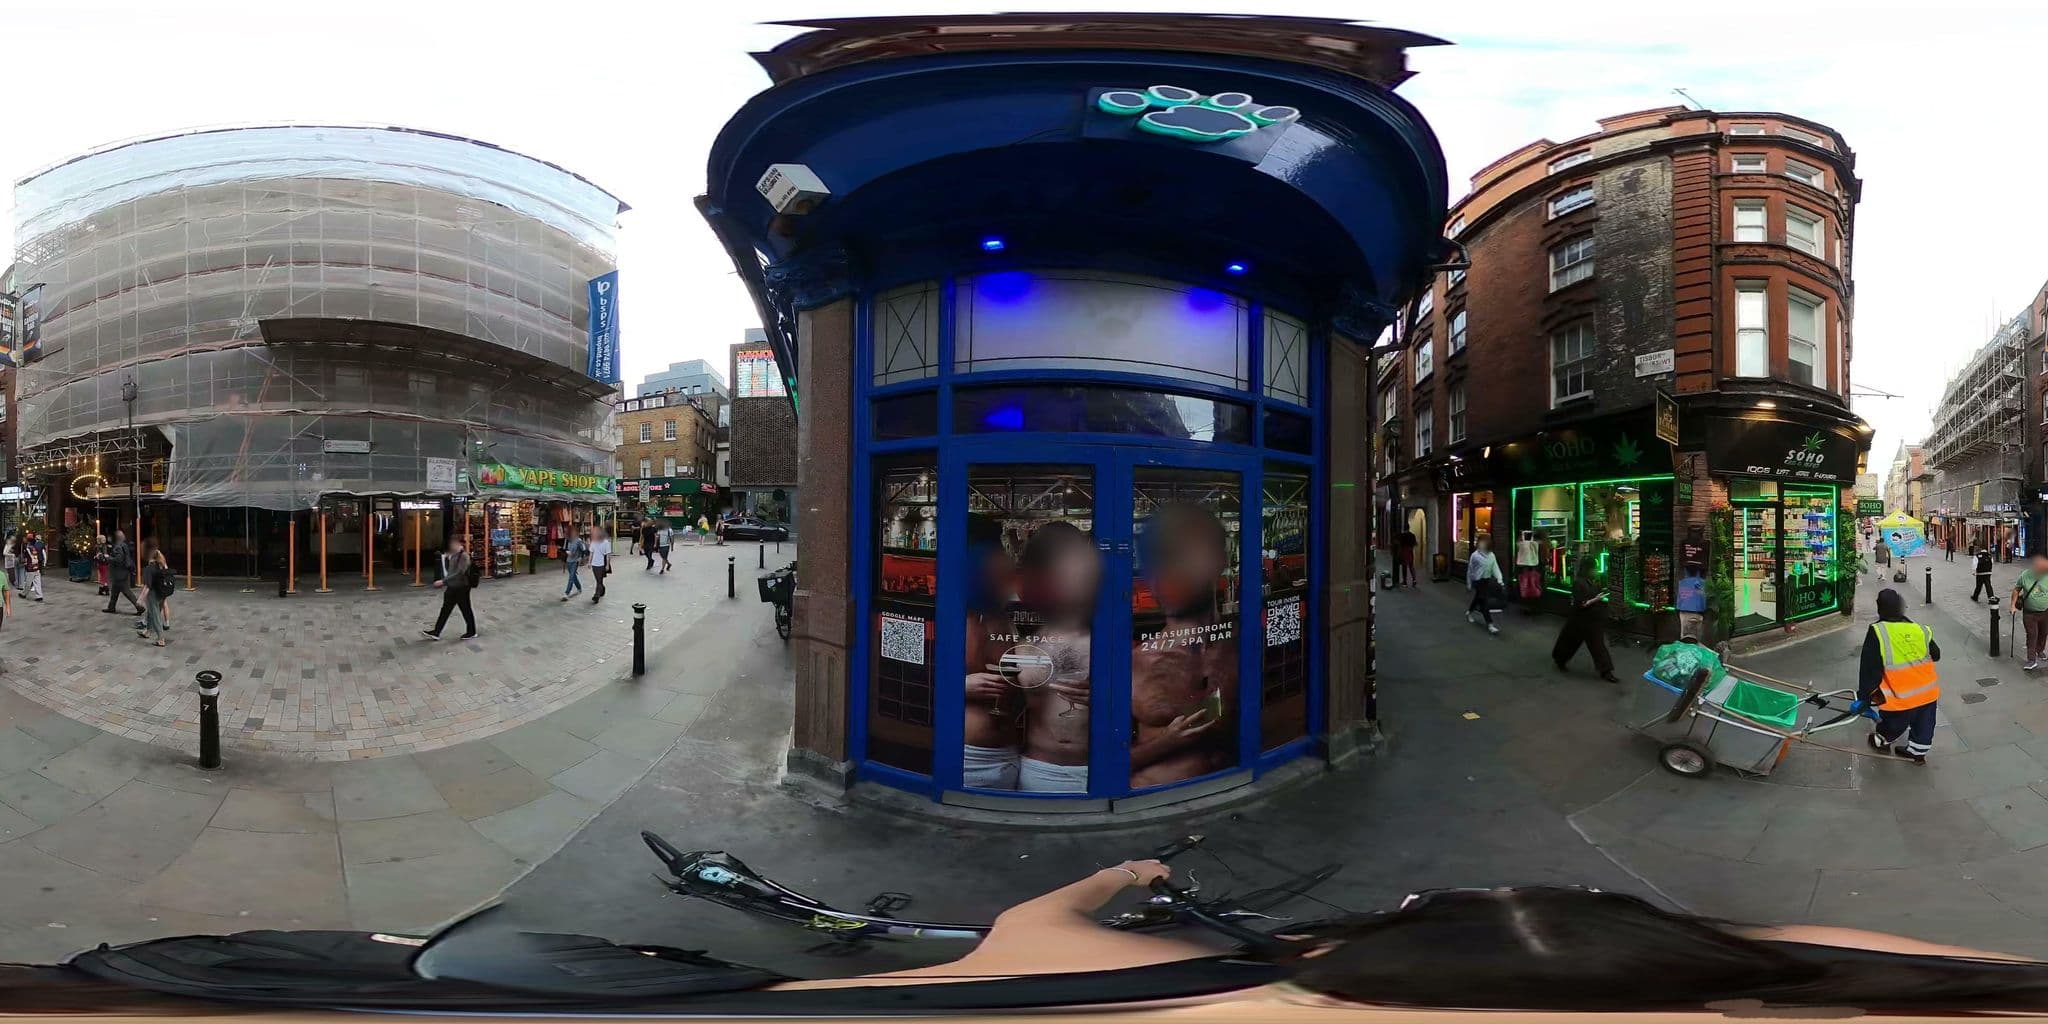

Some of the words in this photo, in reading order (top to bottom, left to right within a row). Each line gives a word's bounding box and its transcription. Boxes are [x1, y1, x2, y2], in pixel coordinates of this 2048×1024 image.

[1786, 449, 1824, 464] SOHO
[1746, 466, 1771, 475] IQOS
[519, 468, 557, 487] VAPE
[562, 473, 596, 489] SHOP
[1859, 502, 1882, 510] SOHO
[1267, 599, 1283, 607] TOUR
[881, 611, 905, 620] GOOGLE
[1141, 621, 1233, 641] PLEASUREDROME
[990, 633, 1020, 643] SAFE
[1025, 635, 1067, 643] SPACE
[1141, 639, 1171, 651] 24/7
[1181, 636, 1204, 646] SPA
[1210, 631, 1232, 642] BAR
